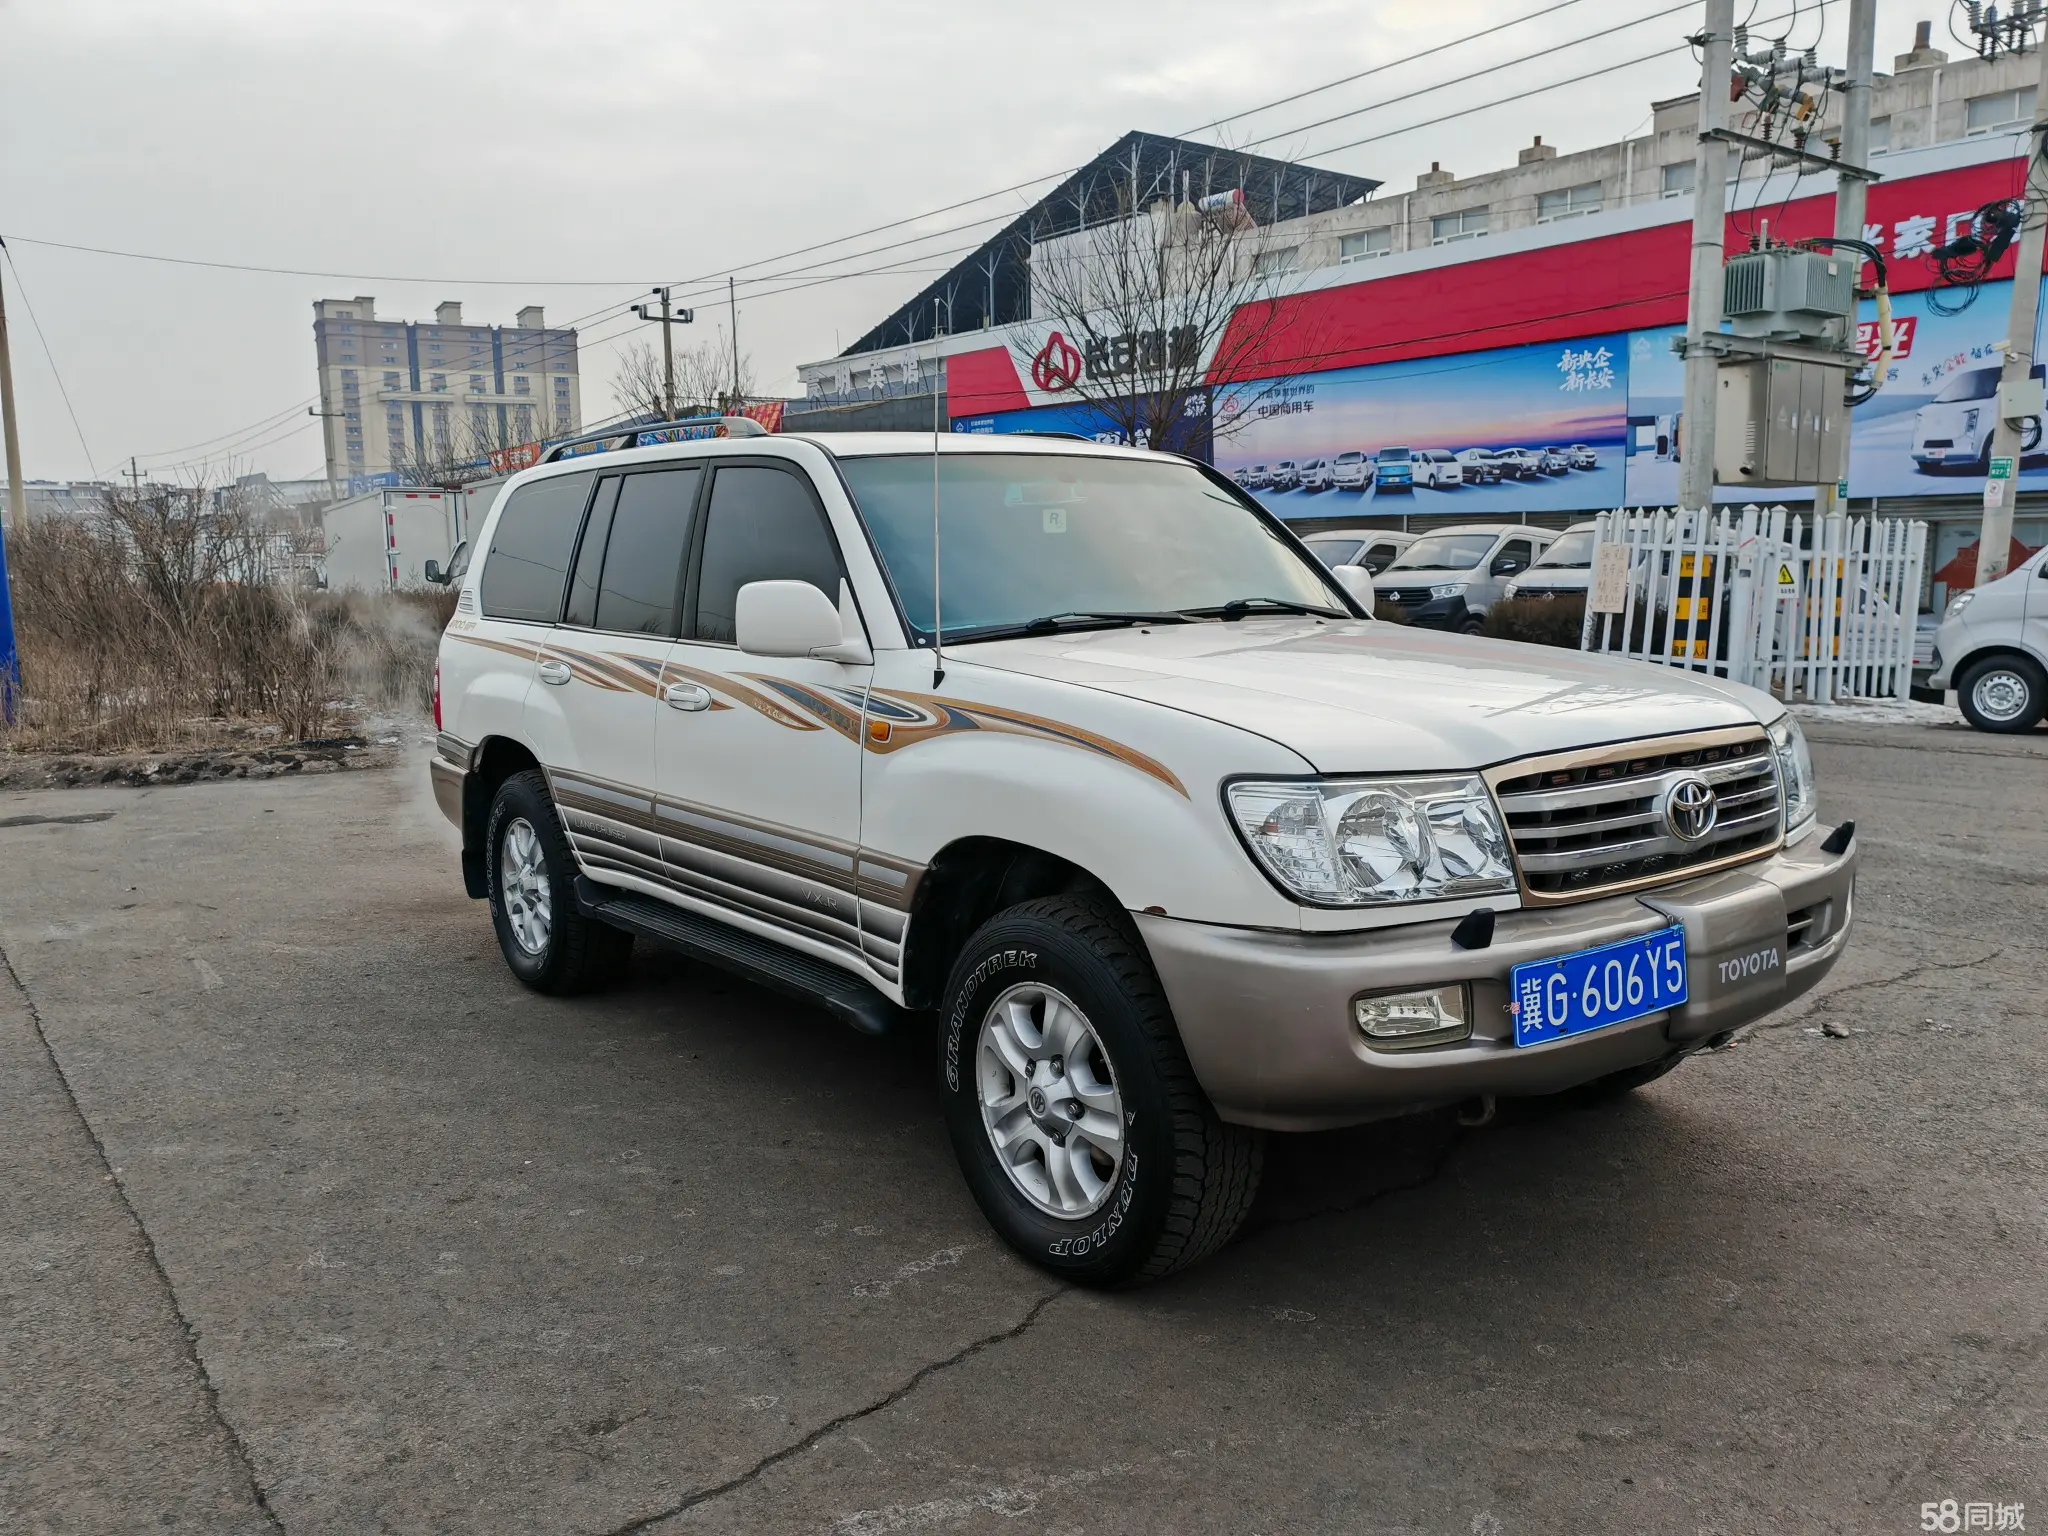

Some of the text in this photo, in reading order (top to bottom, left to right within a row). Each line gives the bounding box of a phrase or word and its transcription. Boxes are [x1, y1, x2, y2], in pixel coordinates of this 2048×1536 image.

[1557, 346, 1614, 372] 新央企
[1560, 367, 1615, 392] 新长安
[1258, 400, 1315, 417] 中国商用车
[574, 815, 628, 841] LAND CRUISER
[1718, 947, 1779, 984] TOYOTA
[1521, 940, 1683, 1034] 冀G·606Y5
[944, 950, 1038, 1093] GRANDTREK
[1049, 1144, 1139, 1256] DUNLOP
